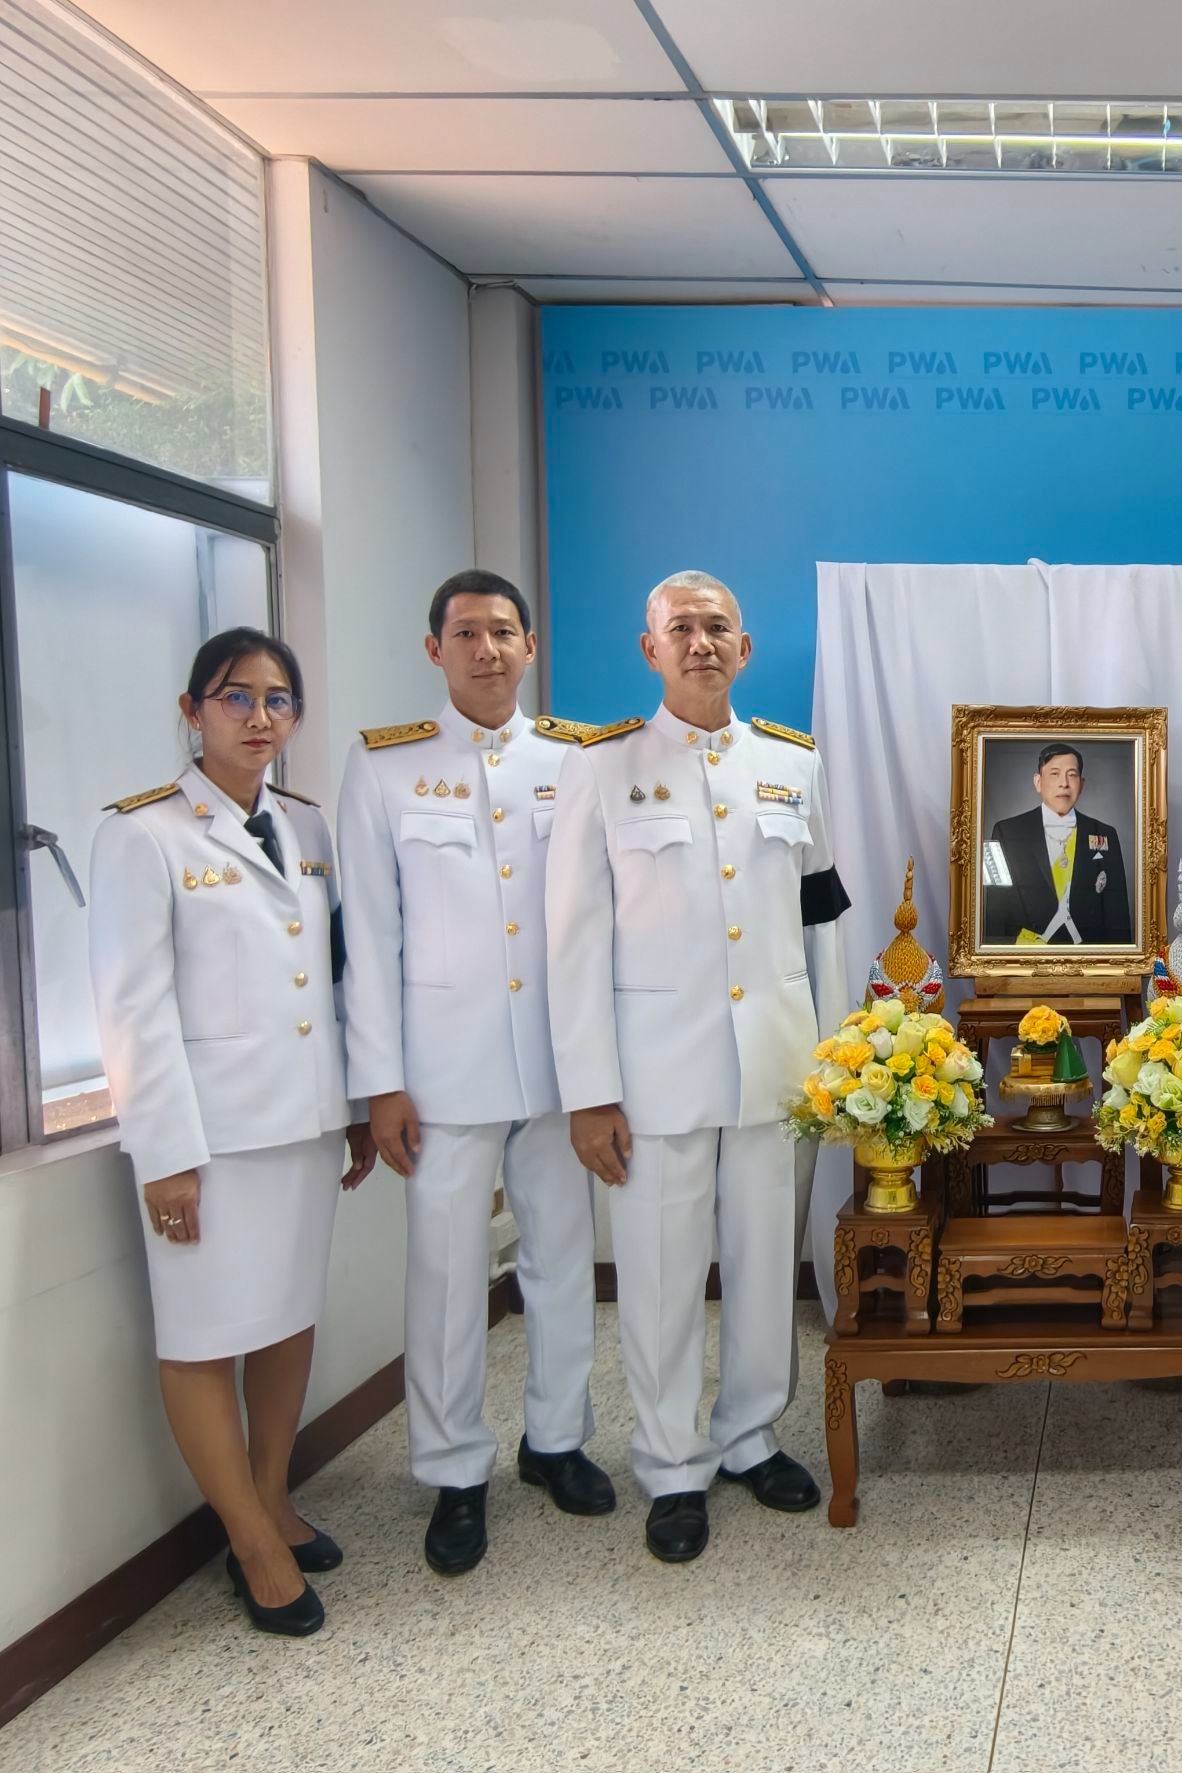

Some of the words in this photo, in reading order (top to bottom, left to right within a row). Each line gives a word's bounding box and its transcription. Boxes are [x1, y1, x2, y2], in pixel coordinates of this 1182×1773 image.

[602, 351, 669, 374] PWA
[697, 351, 764, 374] PWA
[792, 351, 860, 374] PWA
[889, 351, 957, 375] PWA
[984, 351, 1052, 375] PWA
[1080, 352, 1147, 375] PWA
[555, 386, 623, 409] PWA
[650, 387, 717, 410] PWA
[746, 387, 814, 410] PWA
[841, 387, 909, 411] PWA
[936, 387, 1004, 411] PWA
[1032, 388, 1100, 411] PWA
